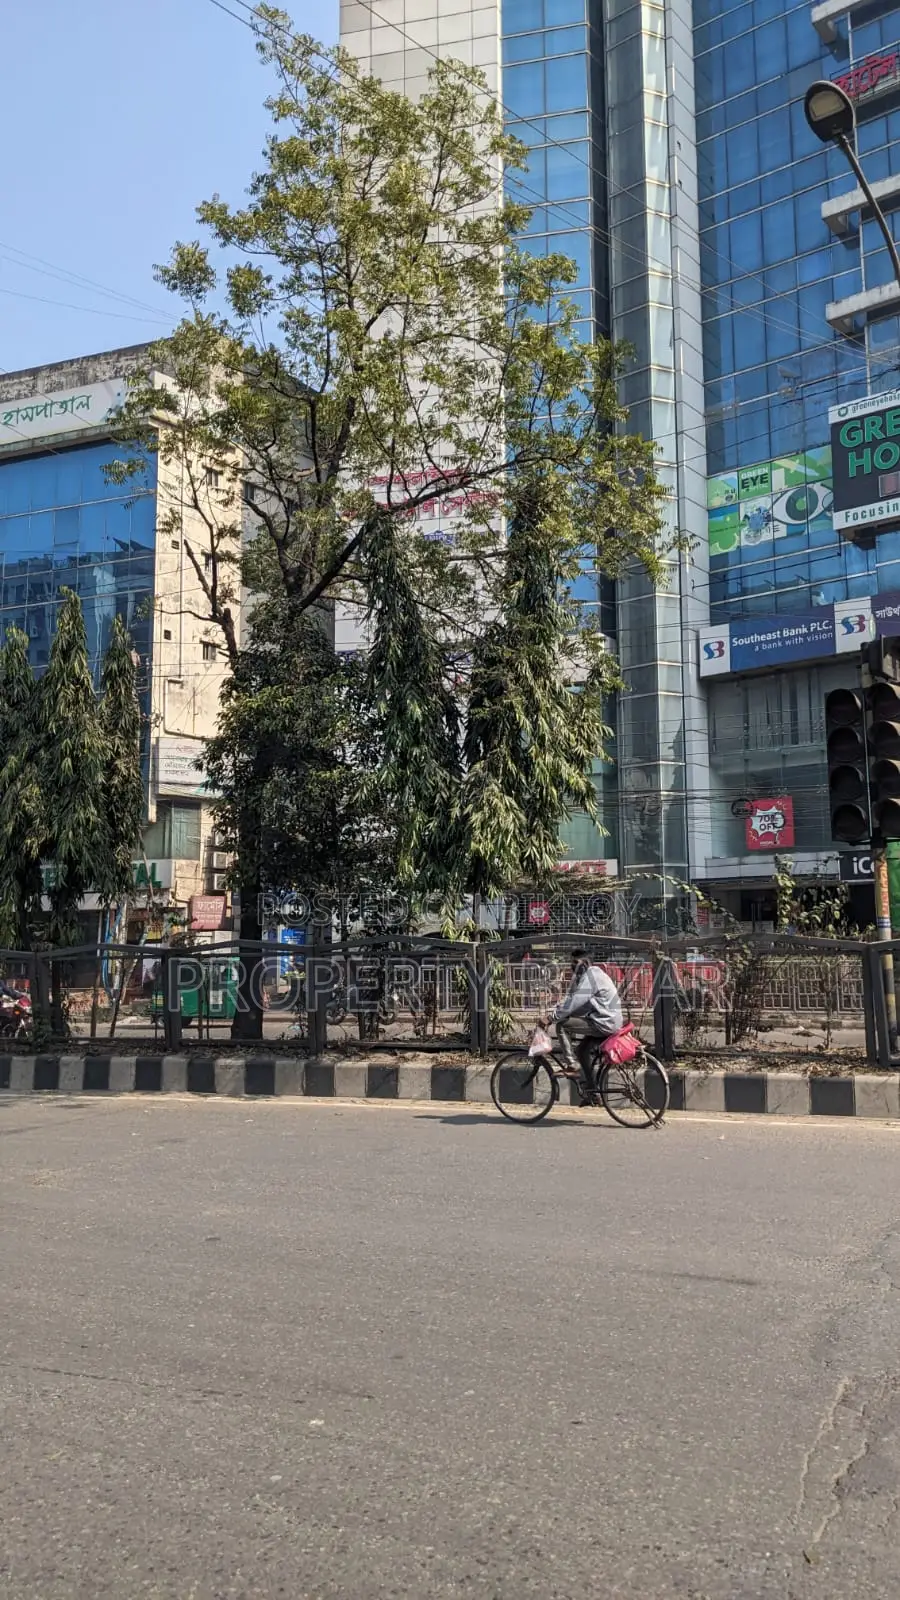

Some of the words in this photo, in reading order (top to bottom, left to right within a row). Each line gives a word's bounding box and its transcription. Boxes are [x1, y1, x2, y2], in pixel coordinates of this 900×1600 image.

[2, 395, 92, 426] হাসপাতাল
[741, 473, 769, 490] EYE
[732, 629, 781, 648] Southeast
[782, 624, 809, 638] Bank
[810, 619, 833, 633] PLC.
[754, 645, 760, 653] a
[761, 640, 783, 651] bank
[784, 636, 805, 647] with
[806, 631, 834, 643] vision
